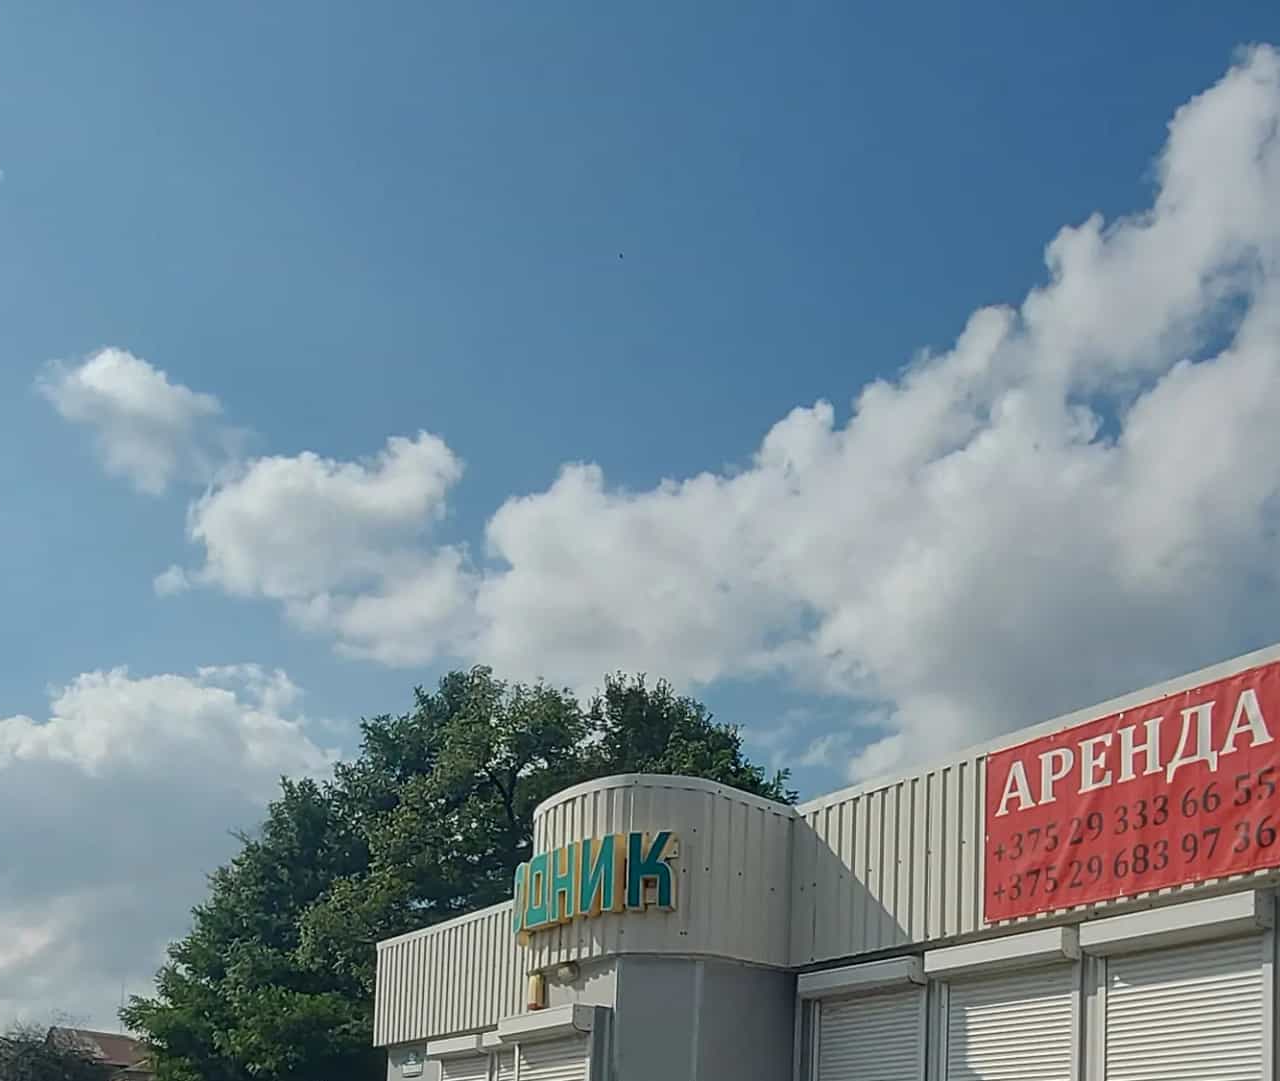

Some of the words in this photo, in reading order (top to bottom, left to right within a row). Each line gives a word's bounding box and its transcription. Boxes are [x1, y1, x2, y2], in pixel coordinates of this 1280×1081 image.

[994, 688, 1275, 817] АРЕНДА
[993, 822, 1059, 863] +375
[1069, 811, 1104, 846] 29
[1113, 794, 1169, 835] 333
[1181, 781, 1222, 818] 66
[1232, 765, 1276, 807] 55
[993, 865, 1059, 902] +375
[1068, 855, 1104, 889] 29
[1113, 839, 1169, 879] 683
[1181, 826, 1222, 865] 97
[1232, 814, 1277, 853] 36
